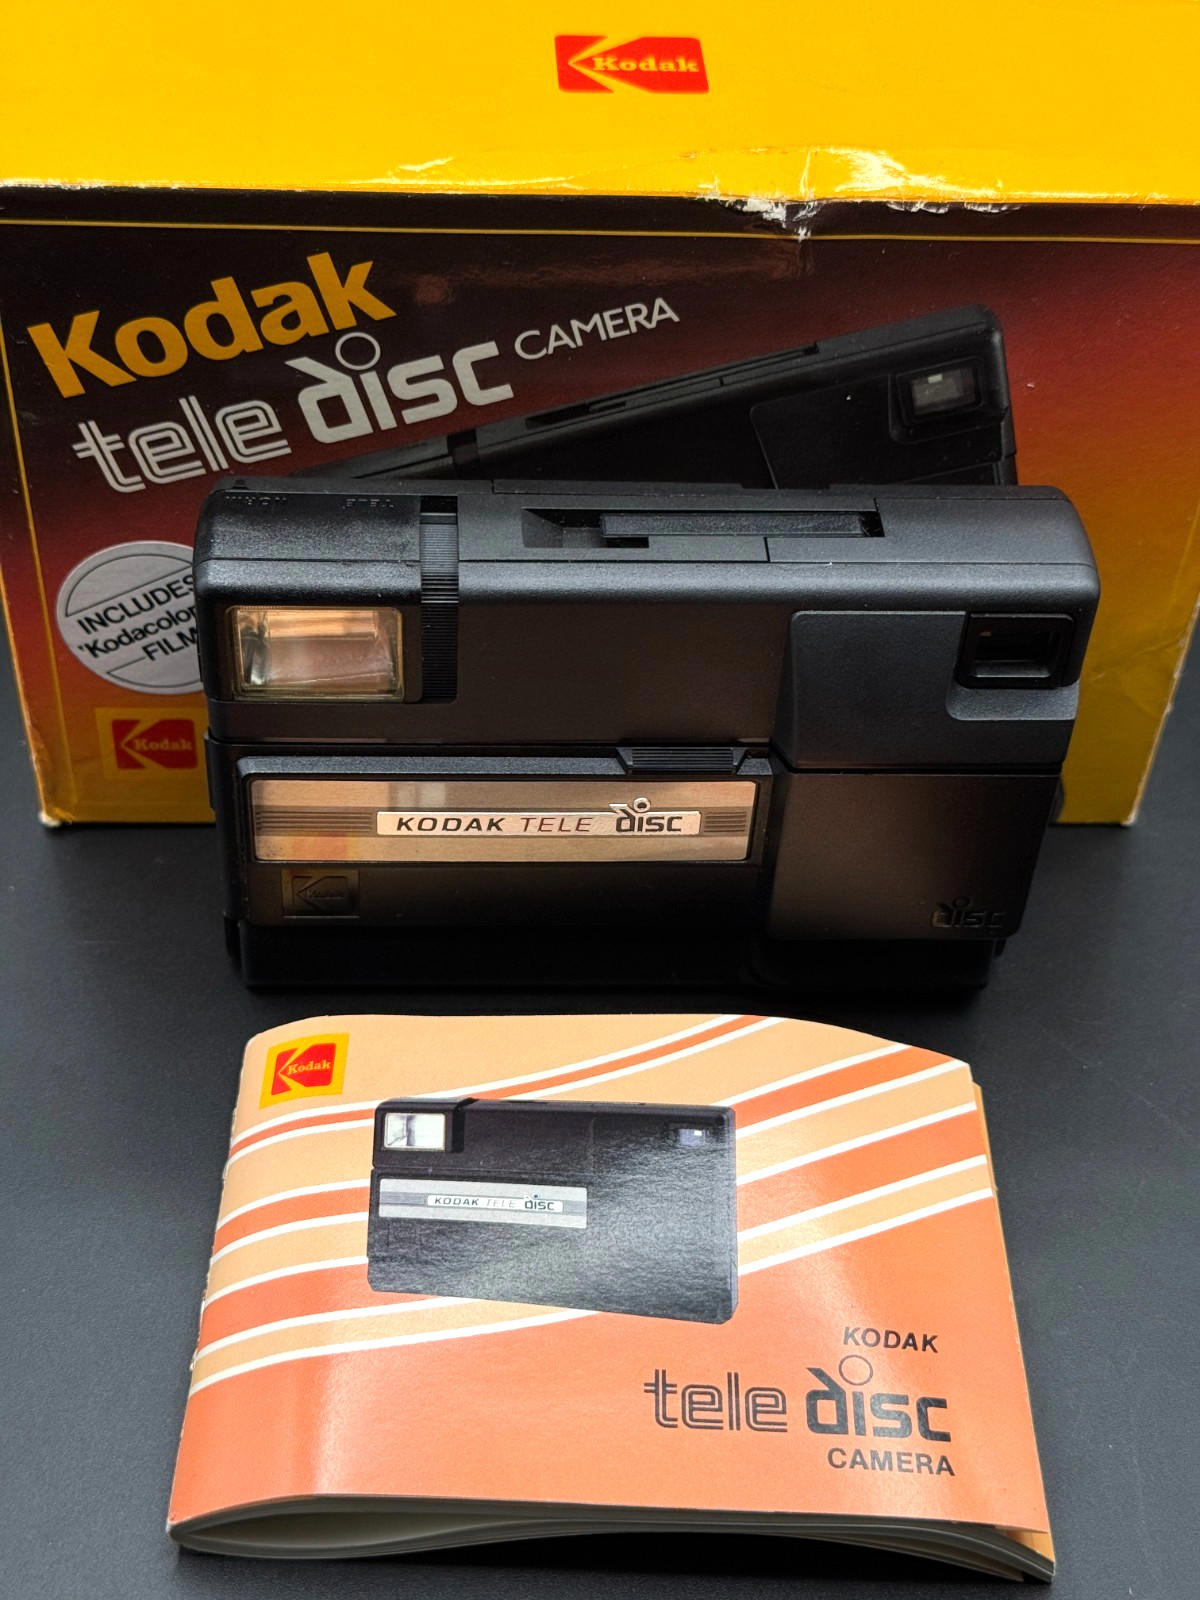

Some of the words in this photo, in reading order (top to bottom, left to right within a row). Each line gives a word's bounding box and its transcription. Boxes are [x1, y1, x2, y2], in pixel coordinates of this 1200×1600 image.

[593, 56, 698, 72] Kodak
[27, 252, 397, 398] Kodak
[73, 395, 291, 493] tele
[285, 332, 514, 444] disc
[514, 297, 680, 360] CAMERA
[77, 575, 194, 635] INCLUDES
[134, 738, 193, 750] Kodak
[396, 817, 505, 832] KODAK
[522, 817, 593, 832] TELE
[610, 797, 683, 832] disc
[287, 1060, 331, 1076] Kodak
[434, 1196, 479, 1206] KODAK
[843, 1326, 938, 1353] KODAK
[644, 1369, 787, 1433] tele
[805, 1355, 951, 1442] disc
[827, 1448, 955, 1476] CAMERA
